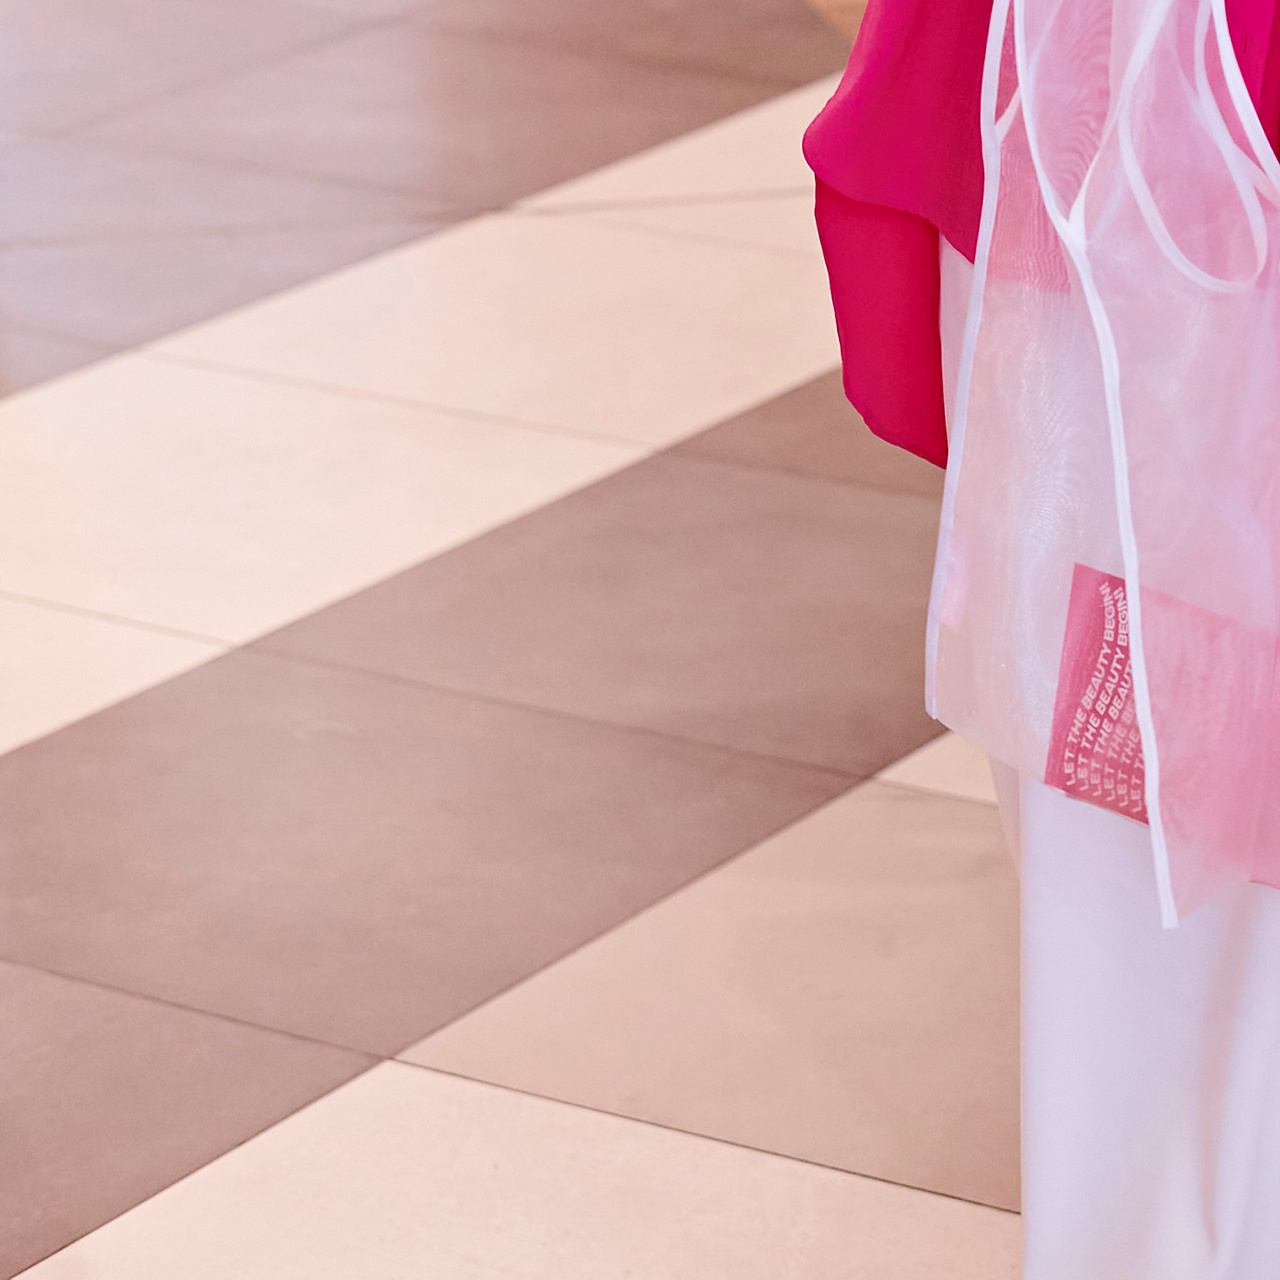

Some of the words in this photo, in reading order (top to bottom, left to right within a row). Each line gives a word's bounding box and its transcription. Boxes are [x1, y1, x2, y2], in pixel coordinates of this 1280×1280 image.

[1100, 582, 1115, 642] BEGIN!
[1081, 642, 1112, 710] BEAUTY
[1095, 647, 1126, 715] BEAUTY
[1108, 658, 1132, 721] BEAUT
[1067, 708, 1088, 744] THE
[1080, 715, 1101, 751] THE
[1093, 718, 1114, 755] THE
[1107, 724, 1128, 760] THE
[1064, 749, 1076, 786] LET
[1077, 754, 1089, 791] LET
[1090, 759, 1102, 796] LET
[1104, 764, 1115, 801] LET
[1117, 769, 1128, 807] LET
[1131, 775, 1142, 813] LET
